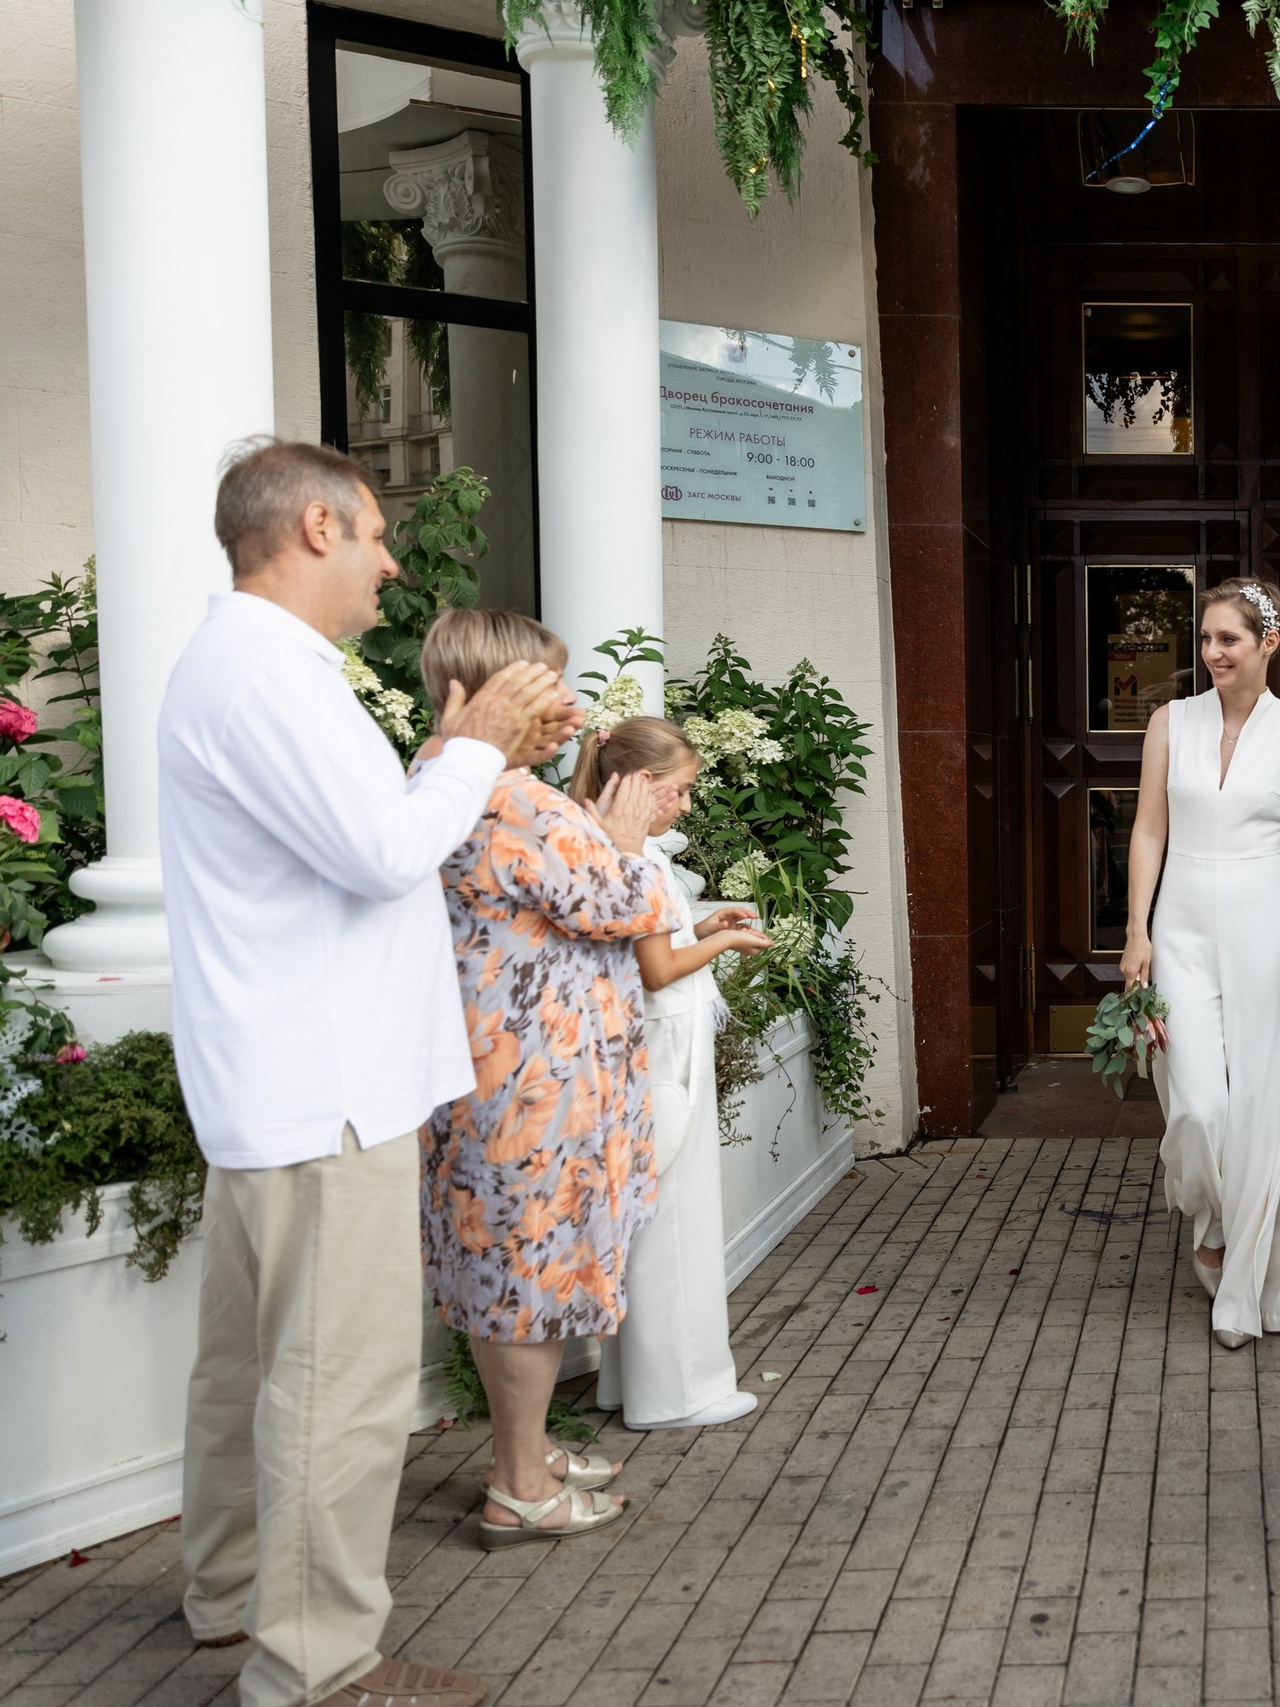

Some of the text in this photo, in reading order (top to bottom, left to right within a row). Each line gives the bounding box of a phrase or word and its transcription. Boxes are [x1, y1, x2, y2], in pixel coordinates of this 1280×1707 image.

[660, 386, 814, 414] Дворец бракосочетания
[689, 427, 786, 447] РЕЖИМ РАБОТЫ
[746, 452, 773, 464] 9:00
[785, 455, 815, 468] 18:00
[699, 468, 738, 477] ПОНЕДЕЛЬНИК
[766, 474, 796, 482] ВЫХОДНОЙ
[687, 491, 742, 502] ЗАГС МОСКВЫ
